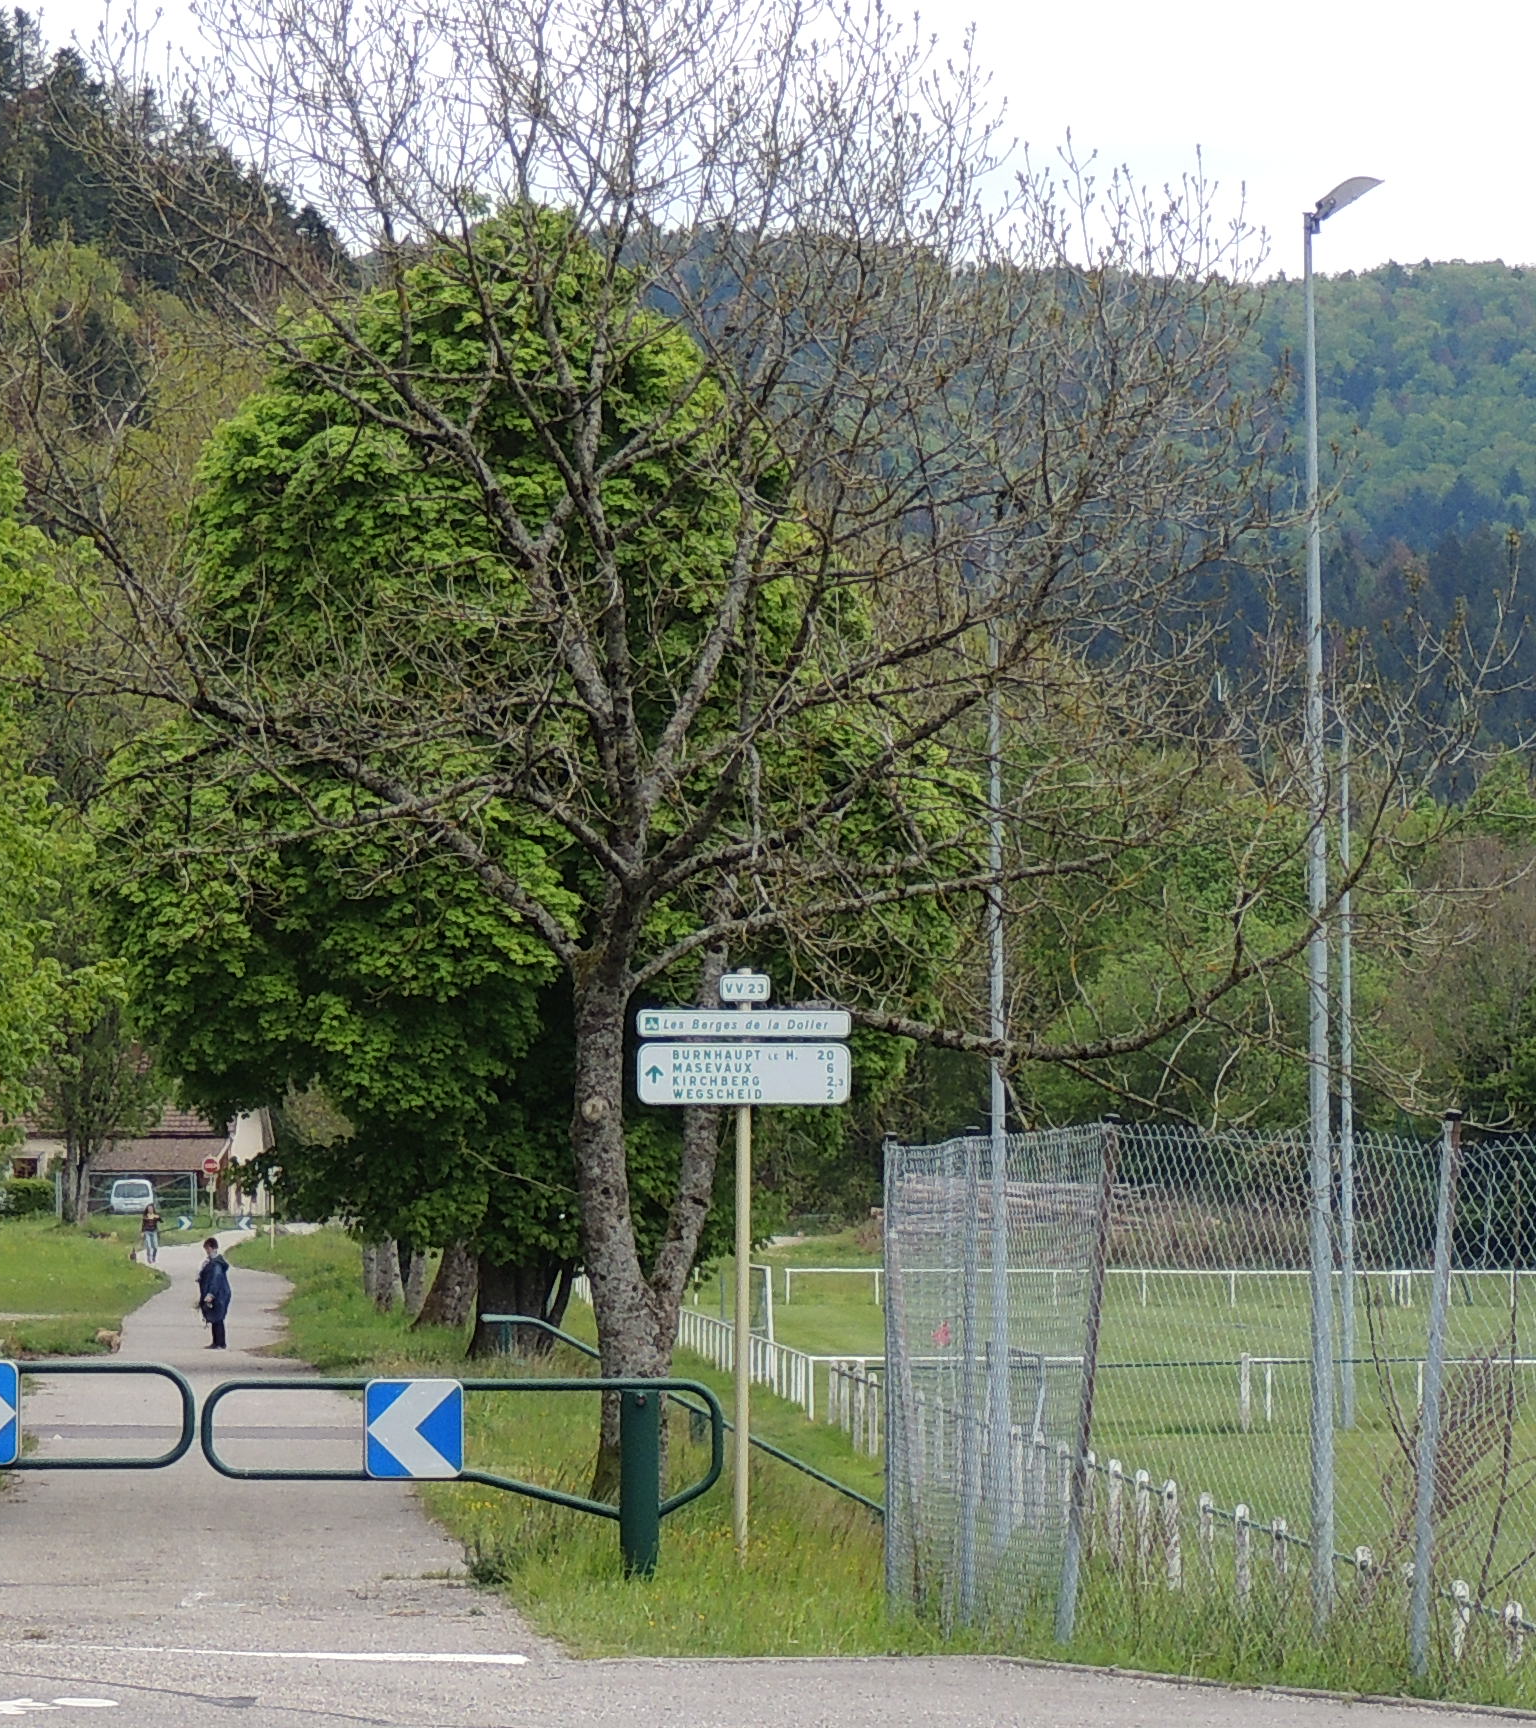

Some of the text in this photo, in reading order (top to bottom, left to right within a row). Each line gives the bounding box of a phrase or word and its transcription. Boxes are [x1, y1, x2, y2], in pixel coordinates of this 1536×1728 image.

[663, 1019, 829, 1032] Les Berges de la Doller
[672, 1050, 761, 1061] BURNHAUPT
[786, 1050, 798, 1061] H.
[817, 1050, 834, 1061] 20
[672, 1063, 834, 1074] MASEVAUX 6
[672, 1076, 844, 1087] KIRCHBERG 2,3
[673, 1089, 834, 1100] WEGSCHEID 2
